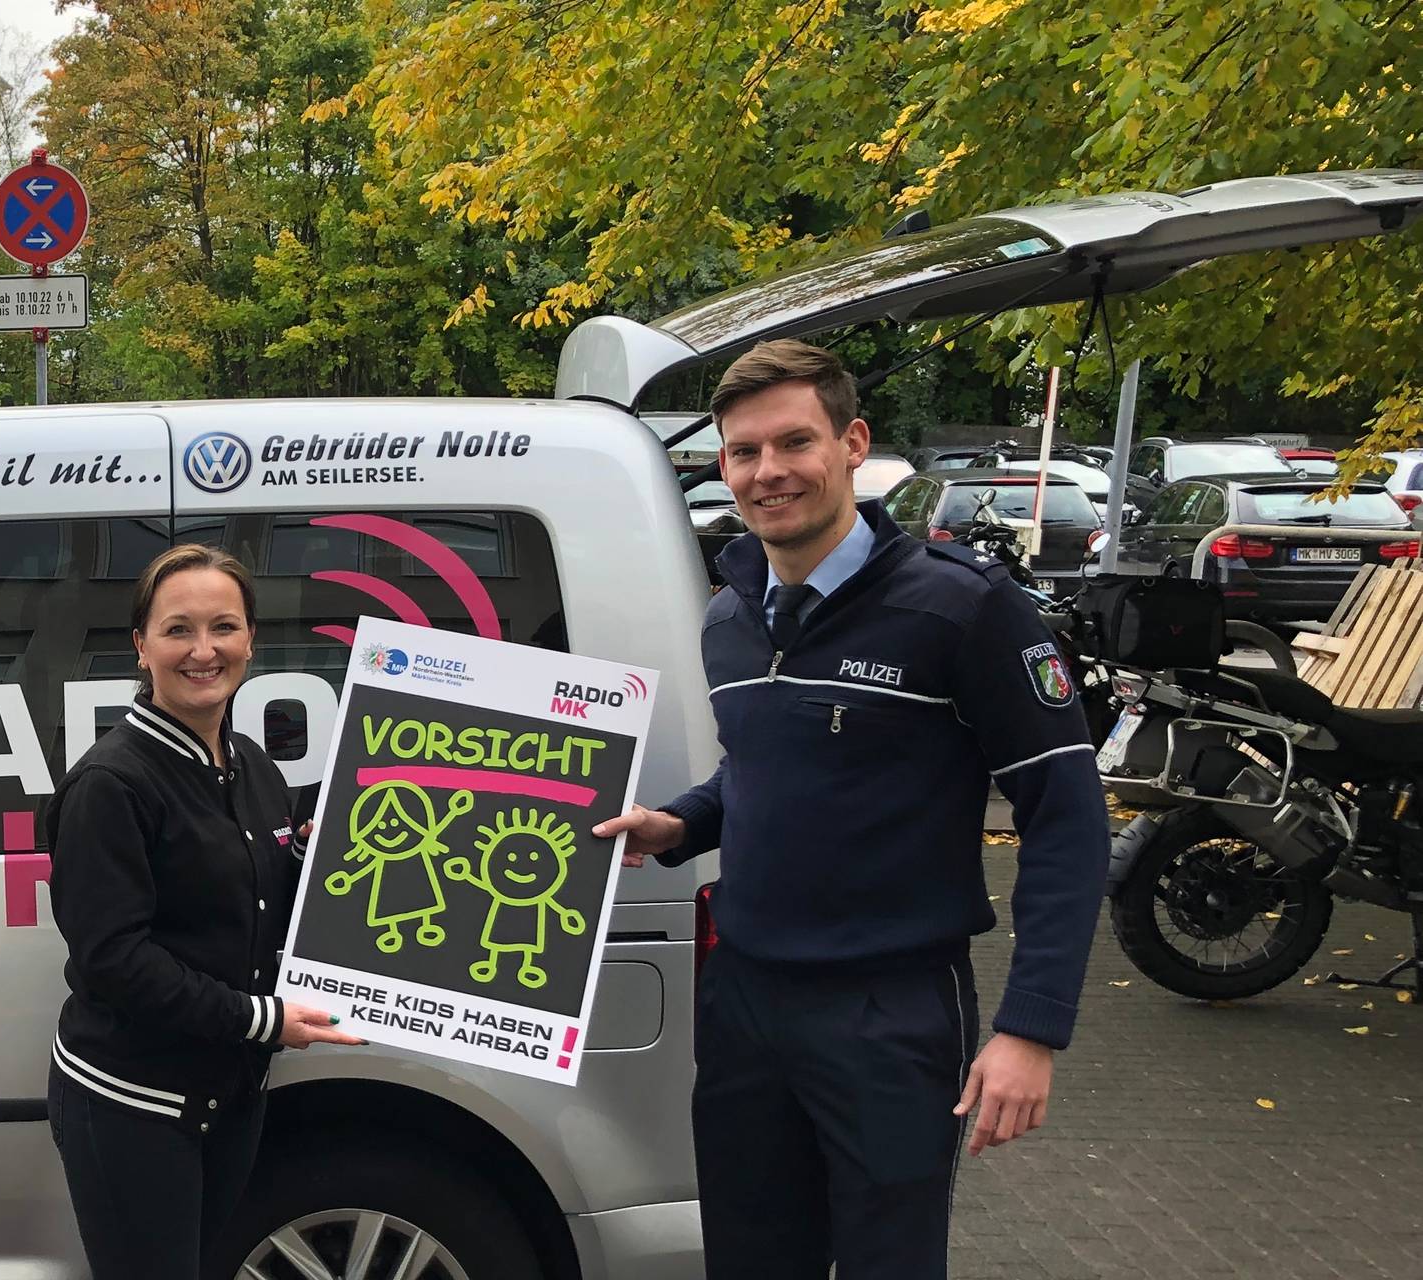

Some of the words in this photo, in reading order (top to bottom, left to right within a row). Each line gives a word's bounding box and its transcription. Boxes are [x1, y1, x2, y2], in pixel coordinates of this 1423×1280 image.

[0, 293, 10, 303] ab
[16, 291, 51, 303] 10.10.22
[57, 291, 63, 302] 6
[68, 291, 73, 301] h
[15, 304, 50, 315] 18.10.22
[57, 303, 65, 314] 17
[72, 303, 77, 313] h
[261, 432, 425, 463] Gebrüder
[435, 430, 531, 458] Nolte
[49, 454, 162, 485] mit...
[261, 470, 298, 486] AM
[305, 466, 425, 485] SEILERSEE.
[1298, 549, 1311, 559] MK
[1335, 549, 1360, 559] 3005
[413, 665, 475, 682] Nordrhein-Westfalen
[415, 654, 467, 673] POLIZEI
[839, 659, 903, 686] POLIZEI
[554, 680, 624, 707] RADIO
[550, 697, 590, 719] MK
[363, 715, 606, 777] VORSICHT
[286, 970, 388, 1004] UNSERE
[395, 993, 454, 1019] KIDS
[463, 1009, 553, 1041] HABEN
[350, 1005, 444, 1037] KEINEN
[451, 1028, 549, 1061] AIRBAG
